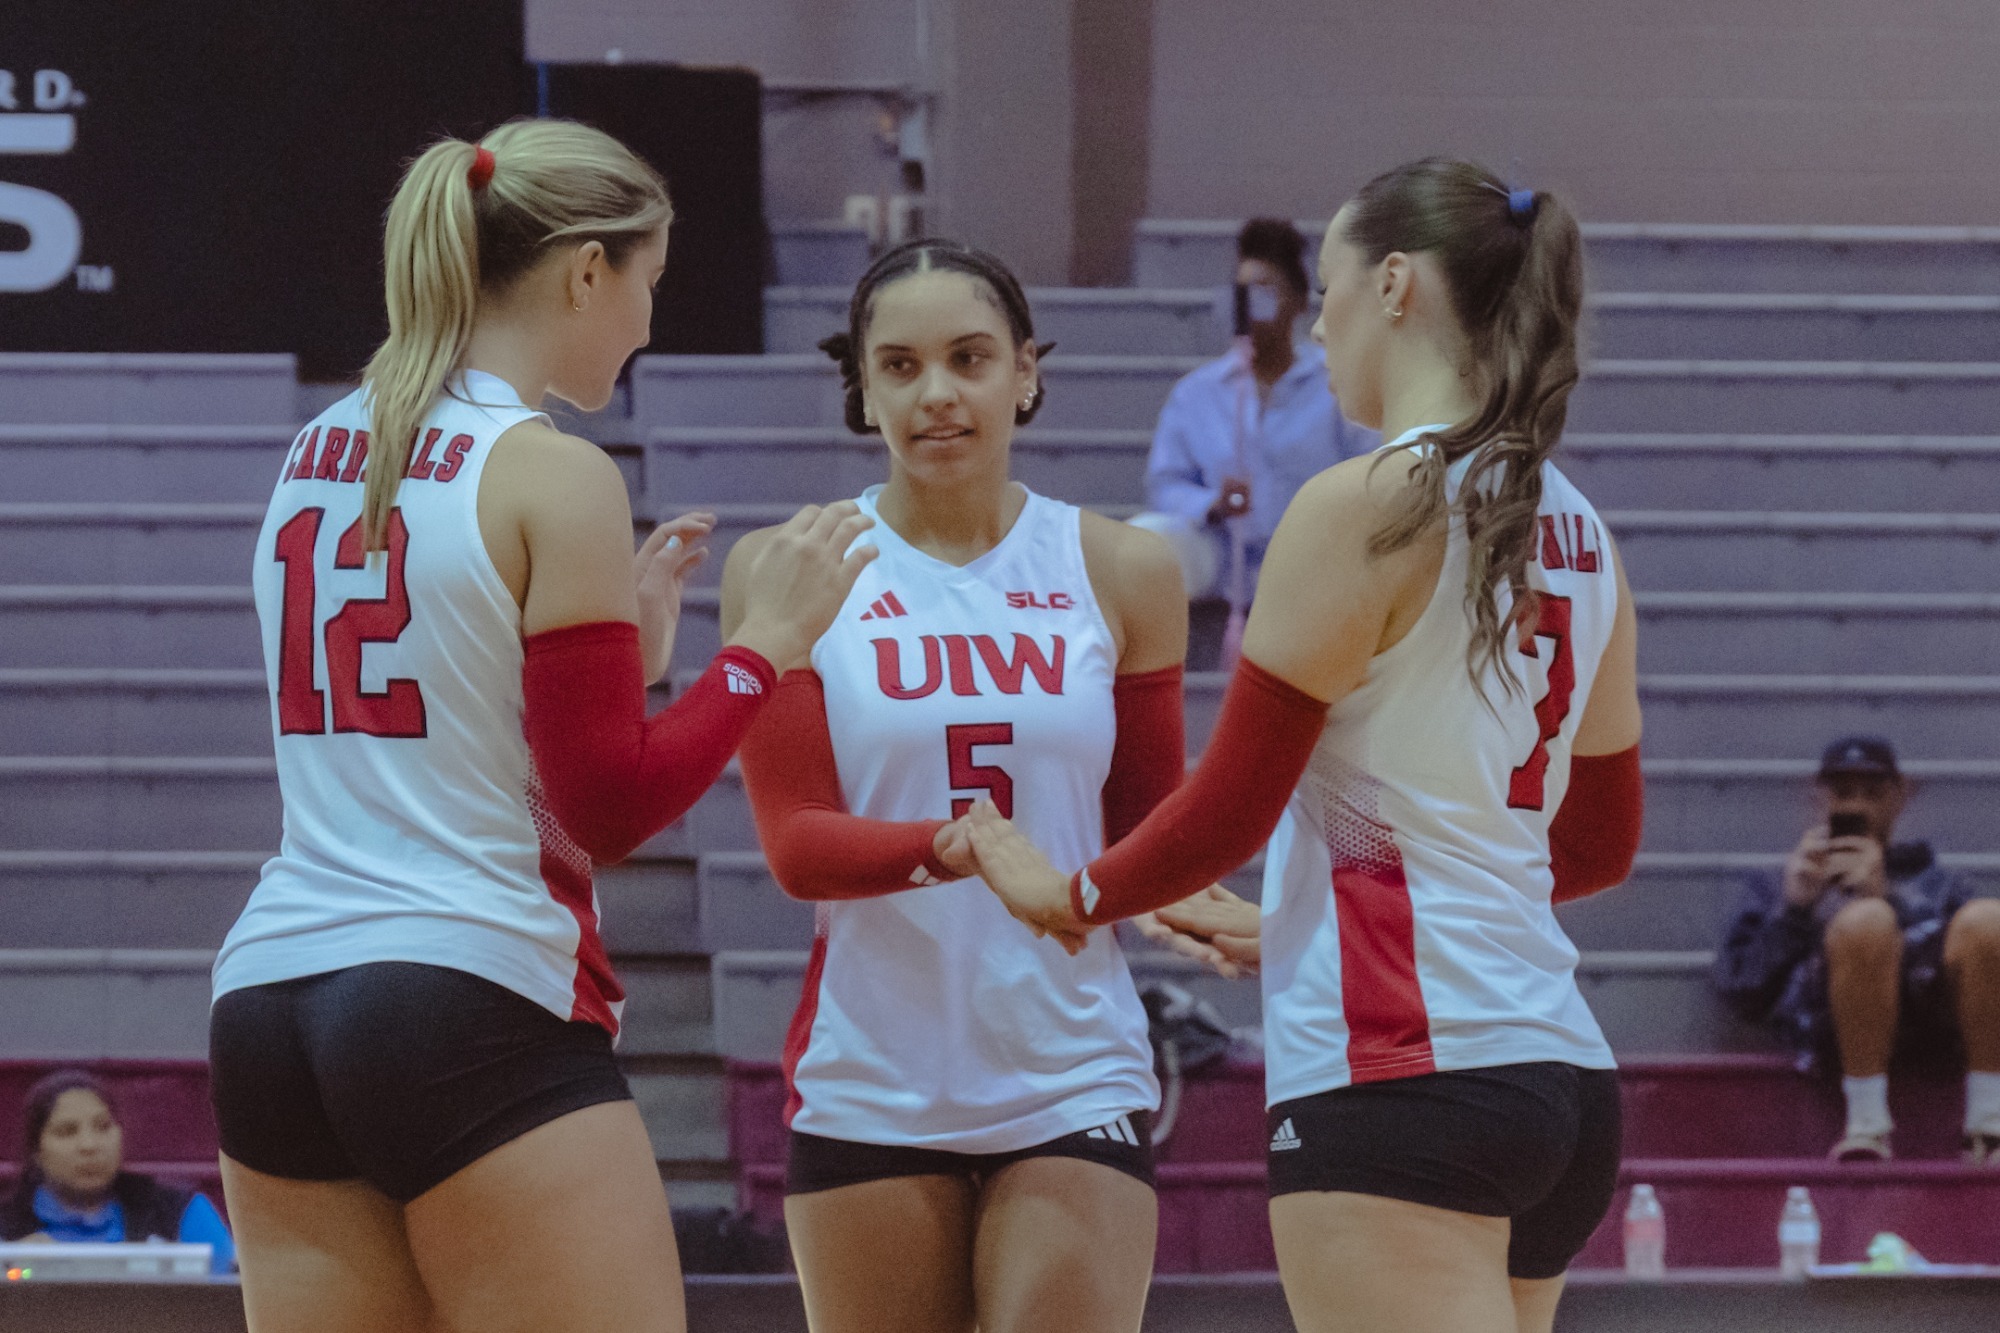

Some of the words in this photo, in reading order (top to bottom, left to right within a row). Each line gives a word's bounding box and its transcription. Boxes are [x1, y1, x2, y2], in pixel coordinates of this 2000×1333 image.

[274, 506, 428, 739] 12
[1005, 591, 1077, 610] SLC
[869, 632, 1066, 700] UIW
[1507, 590, 1575, 812] 7
[945, 722, 1013, 822] 5
